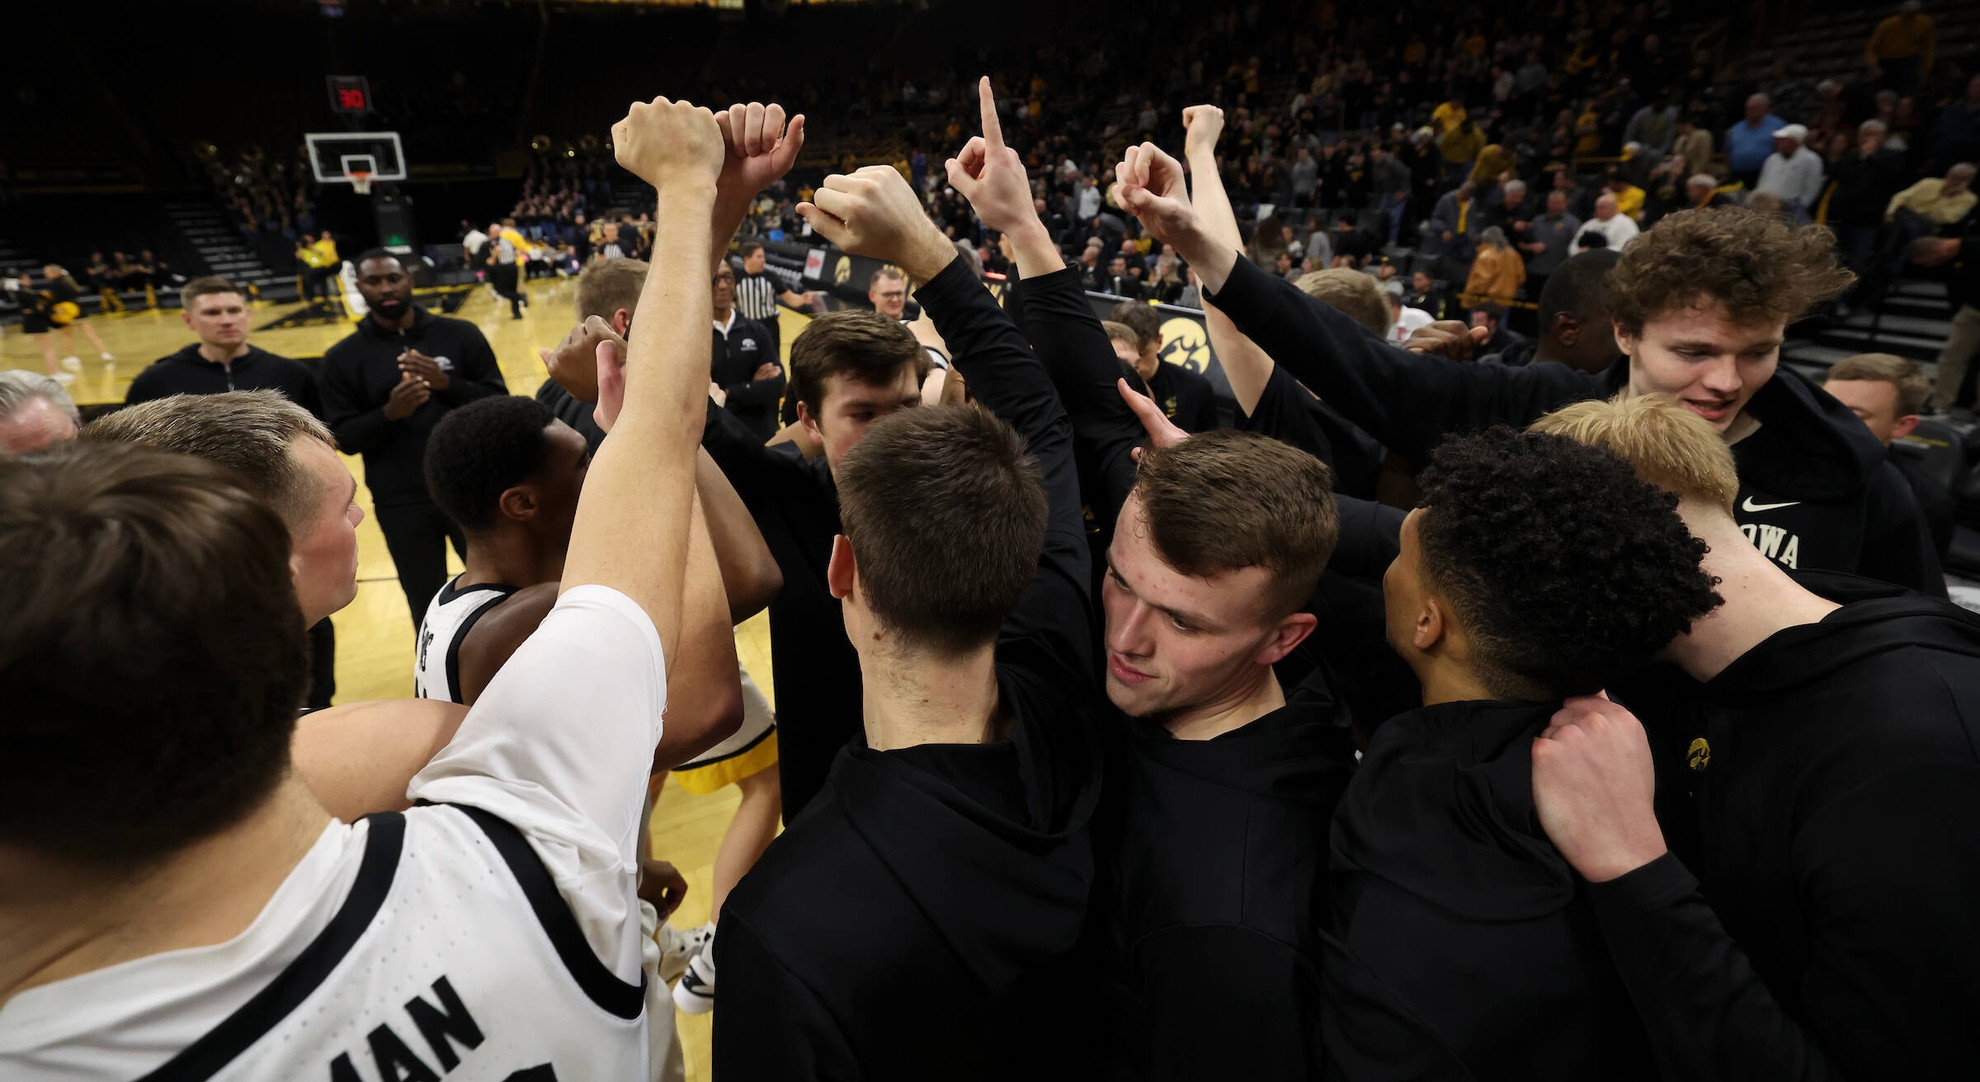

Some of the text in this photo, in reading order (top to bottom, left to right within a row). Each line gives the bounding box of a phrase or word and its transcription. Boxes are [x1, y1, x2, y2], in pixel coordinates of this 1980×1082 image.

[339, 88, 366, 109] 30
[1740, 523, 1799, 569] OWA
[330, 974, 486, 1082] AN
